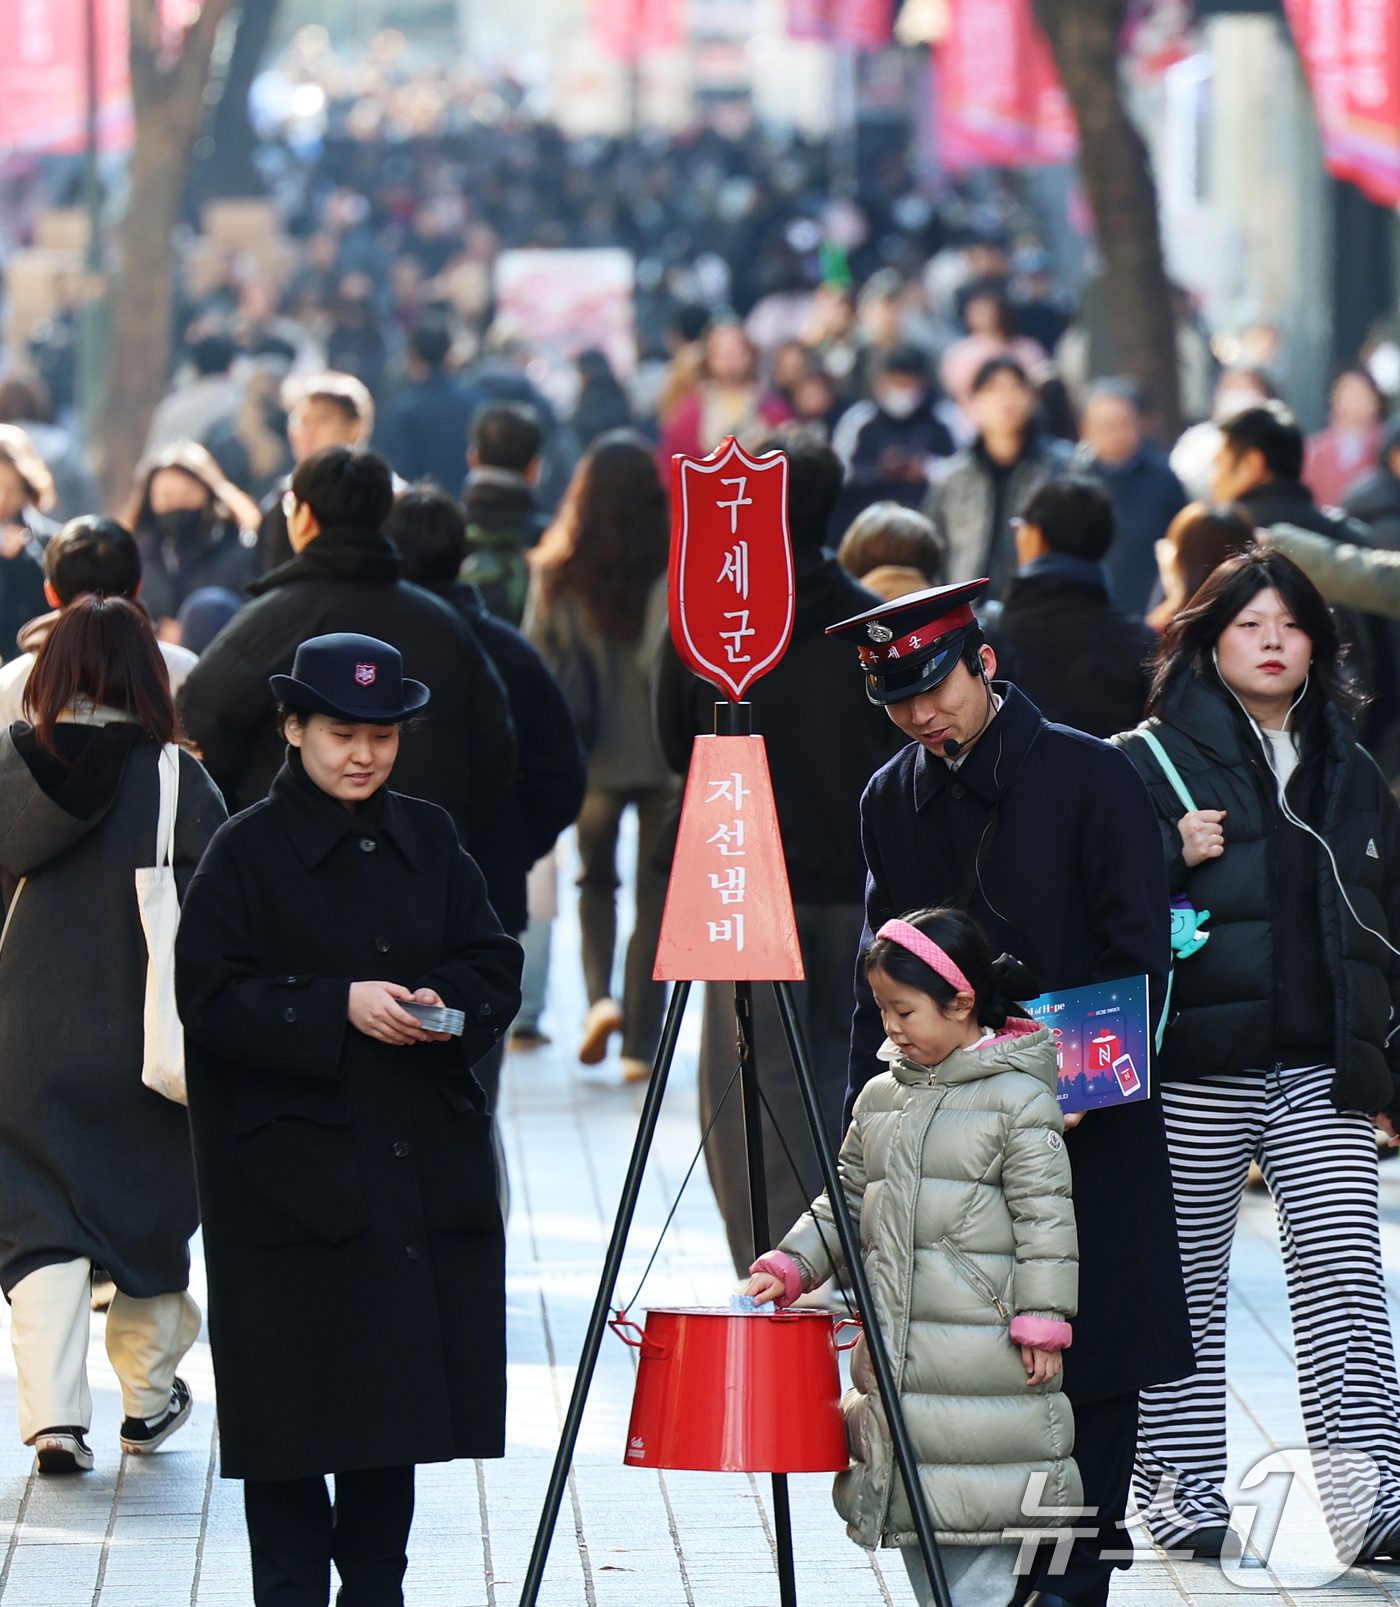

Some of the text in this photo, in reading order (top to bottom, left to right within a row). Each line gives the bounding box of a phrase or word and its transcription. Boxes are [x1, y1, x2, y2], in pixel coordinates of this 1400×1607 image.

[715, 476, 756, 663] 구세군
[869, 635, 922, 663] 구세군
[704, 772, 752, 952] 자선냄비
